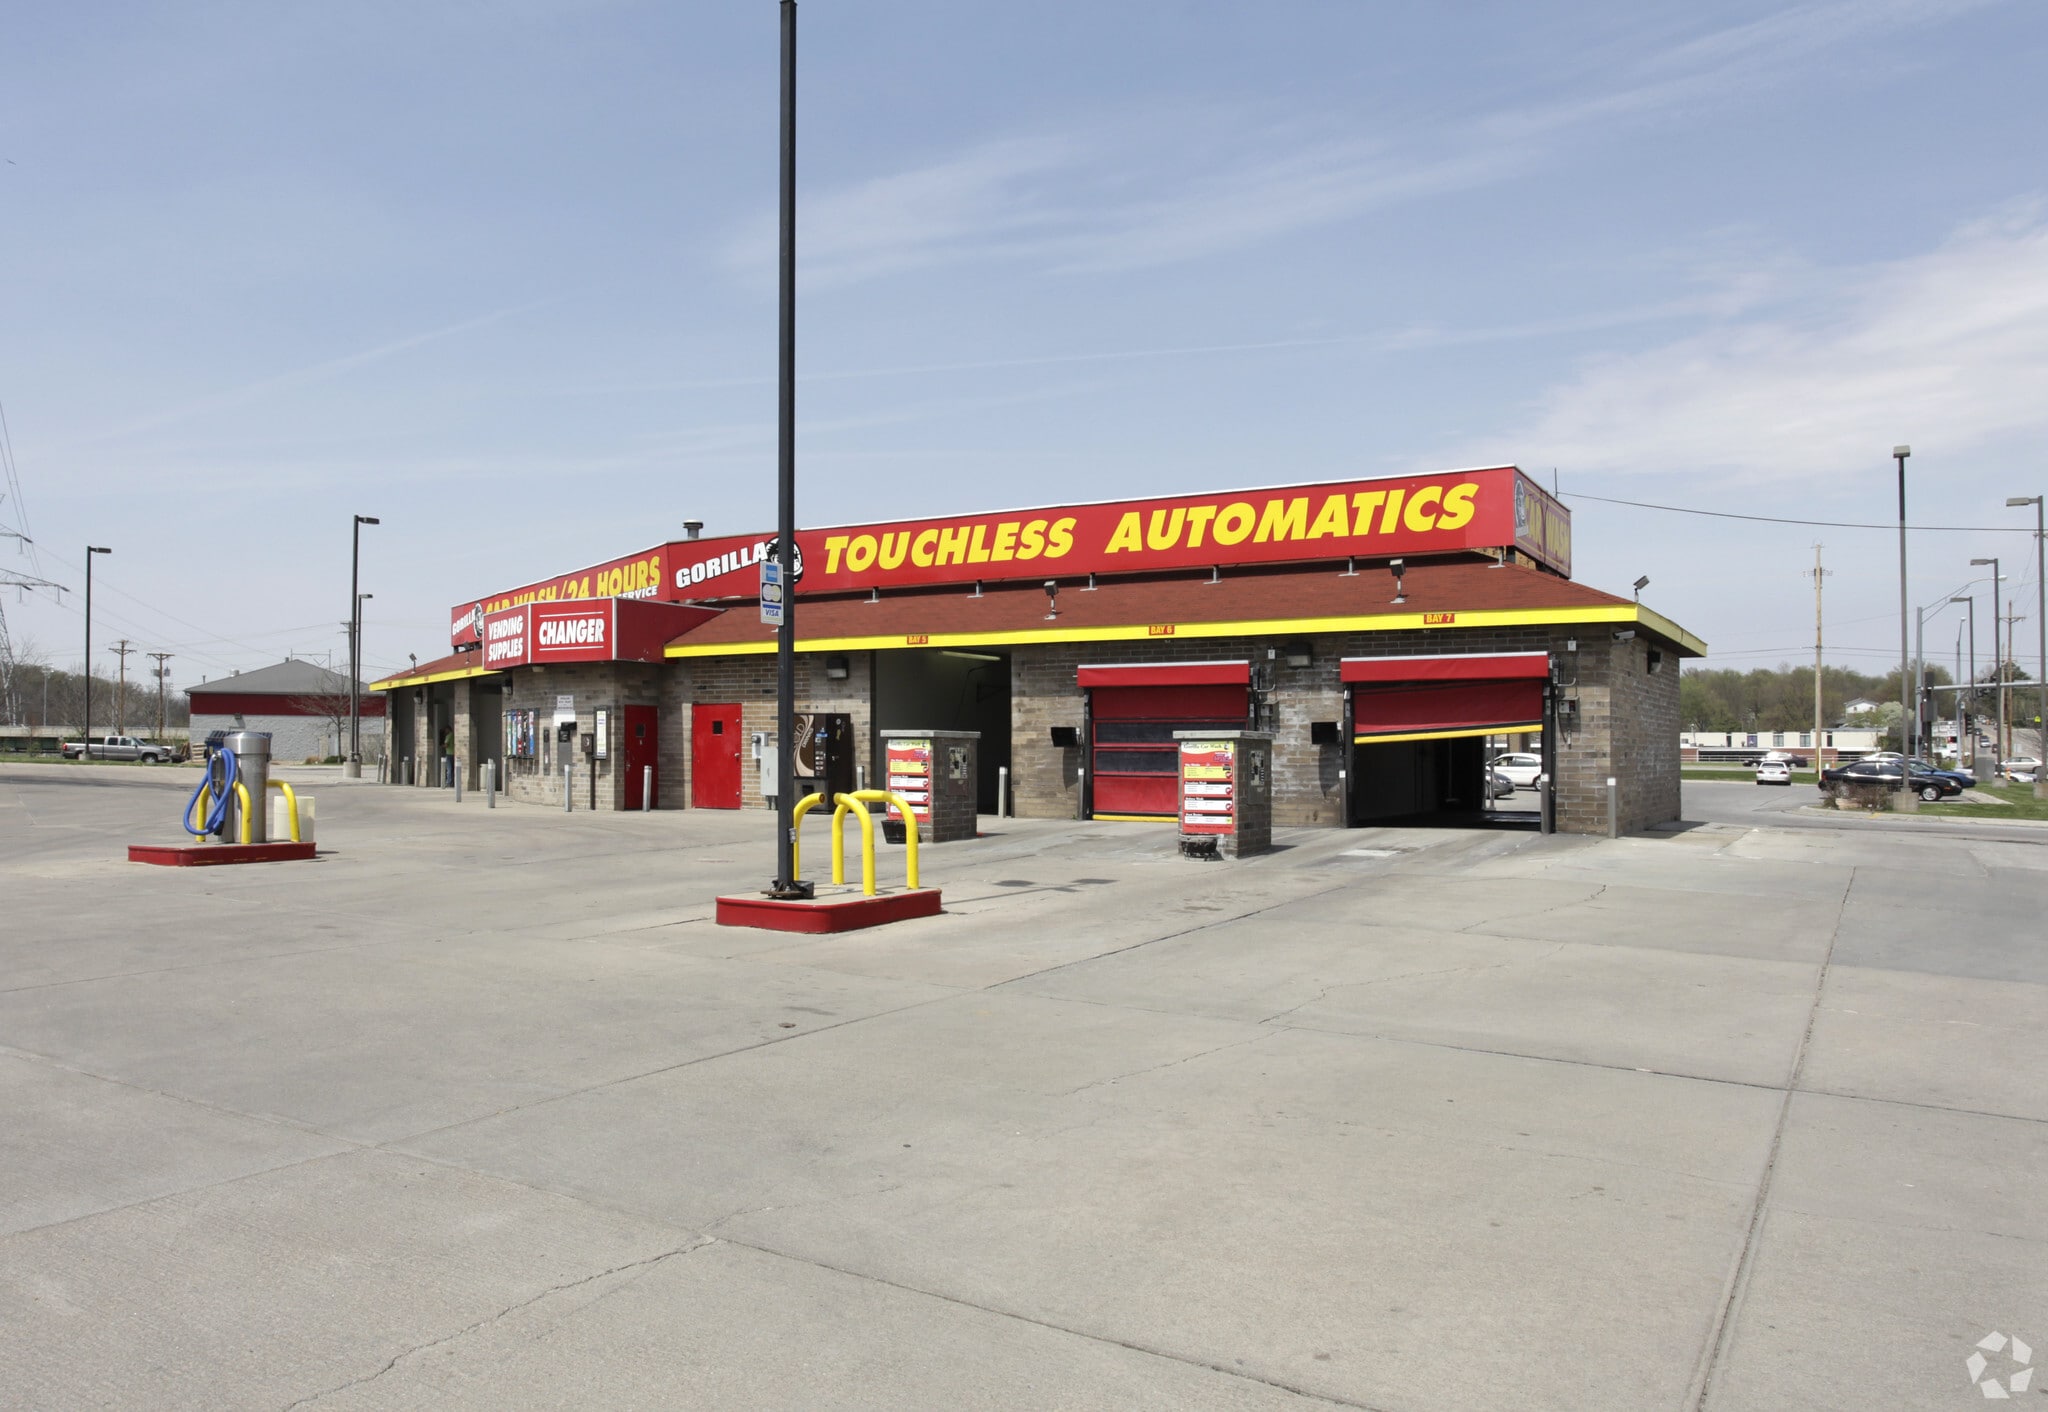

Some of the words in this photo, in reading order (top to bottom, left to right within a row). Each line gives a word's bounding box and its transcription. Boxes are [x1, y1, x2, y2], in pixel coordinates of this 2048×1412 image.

[825, 517, 1077, 574] TOUCHLESS
[1105, 483, 1479, 554] AUTOMATICS
[597, 556, 661, 598] HOURS
[675, 541, 768, 589] GORILLA
[765, 609, 779, 617] VISA
[1426, 614, 1443, 623] BAY
[1446, 614, 1452, 622] 7
[488, 615, 523, 641] VENDING
[539, 618, 605, 645] CHANGER
[1150, 625, 1165, 634] BAY
[1167, 625, 1173, 634] 6
[488, 638, 523, 662] SUPPLIES
